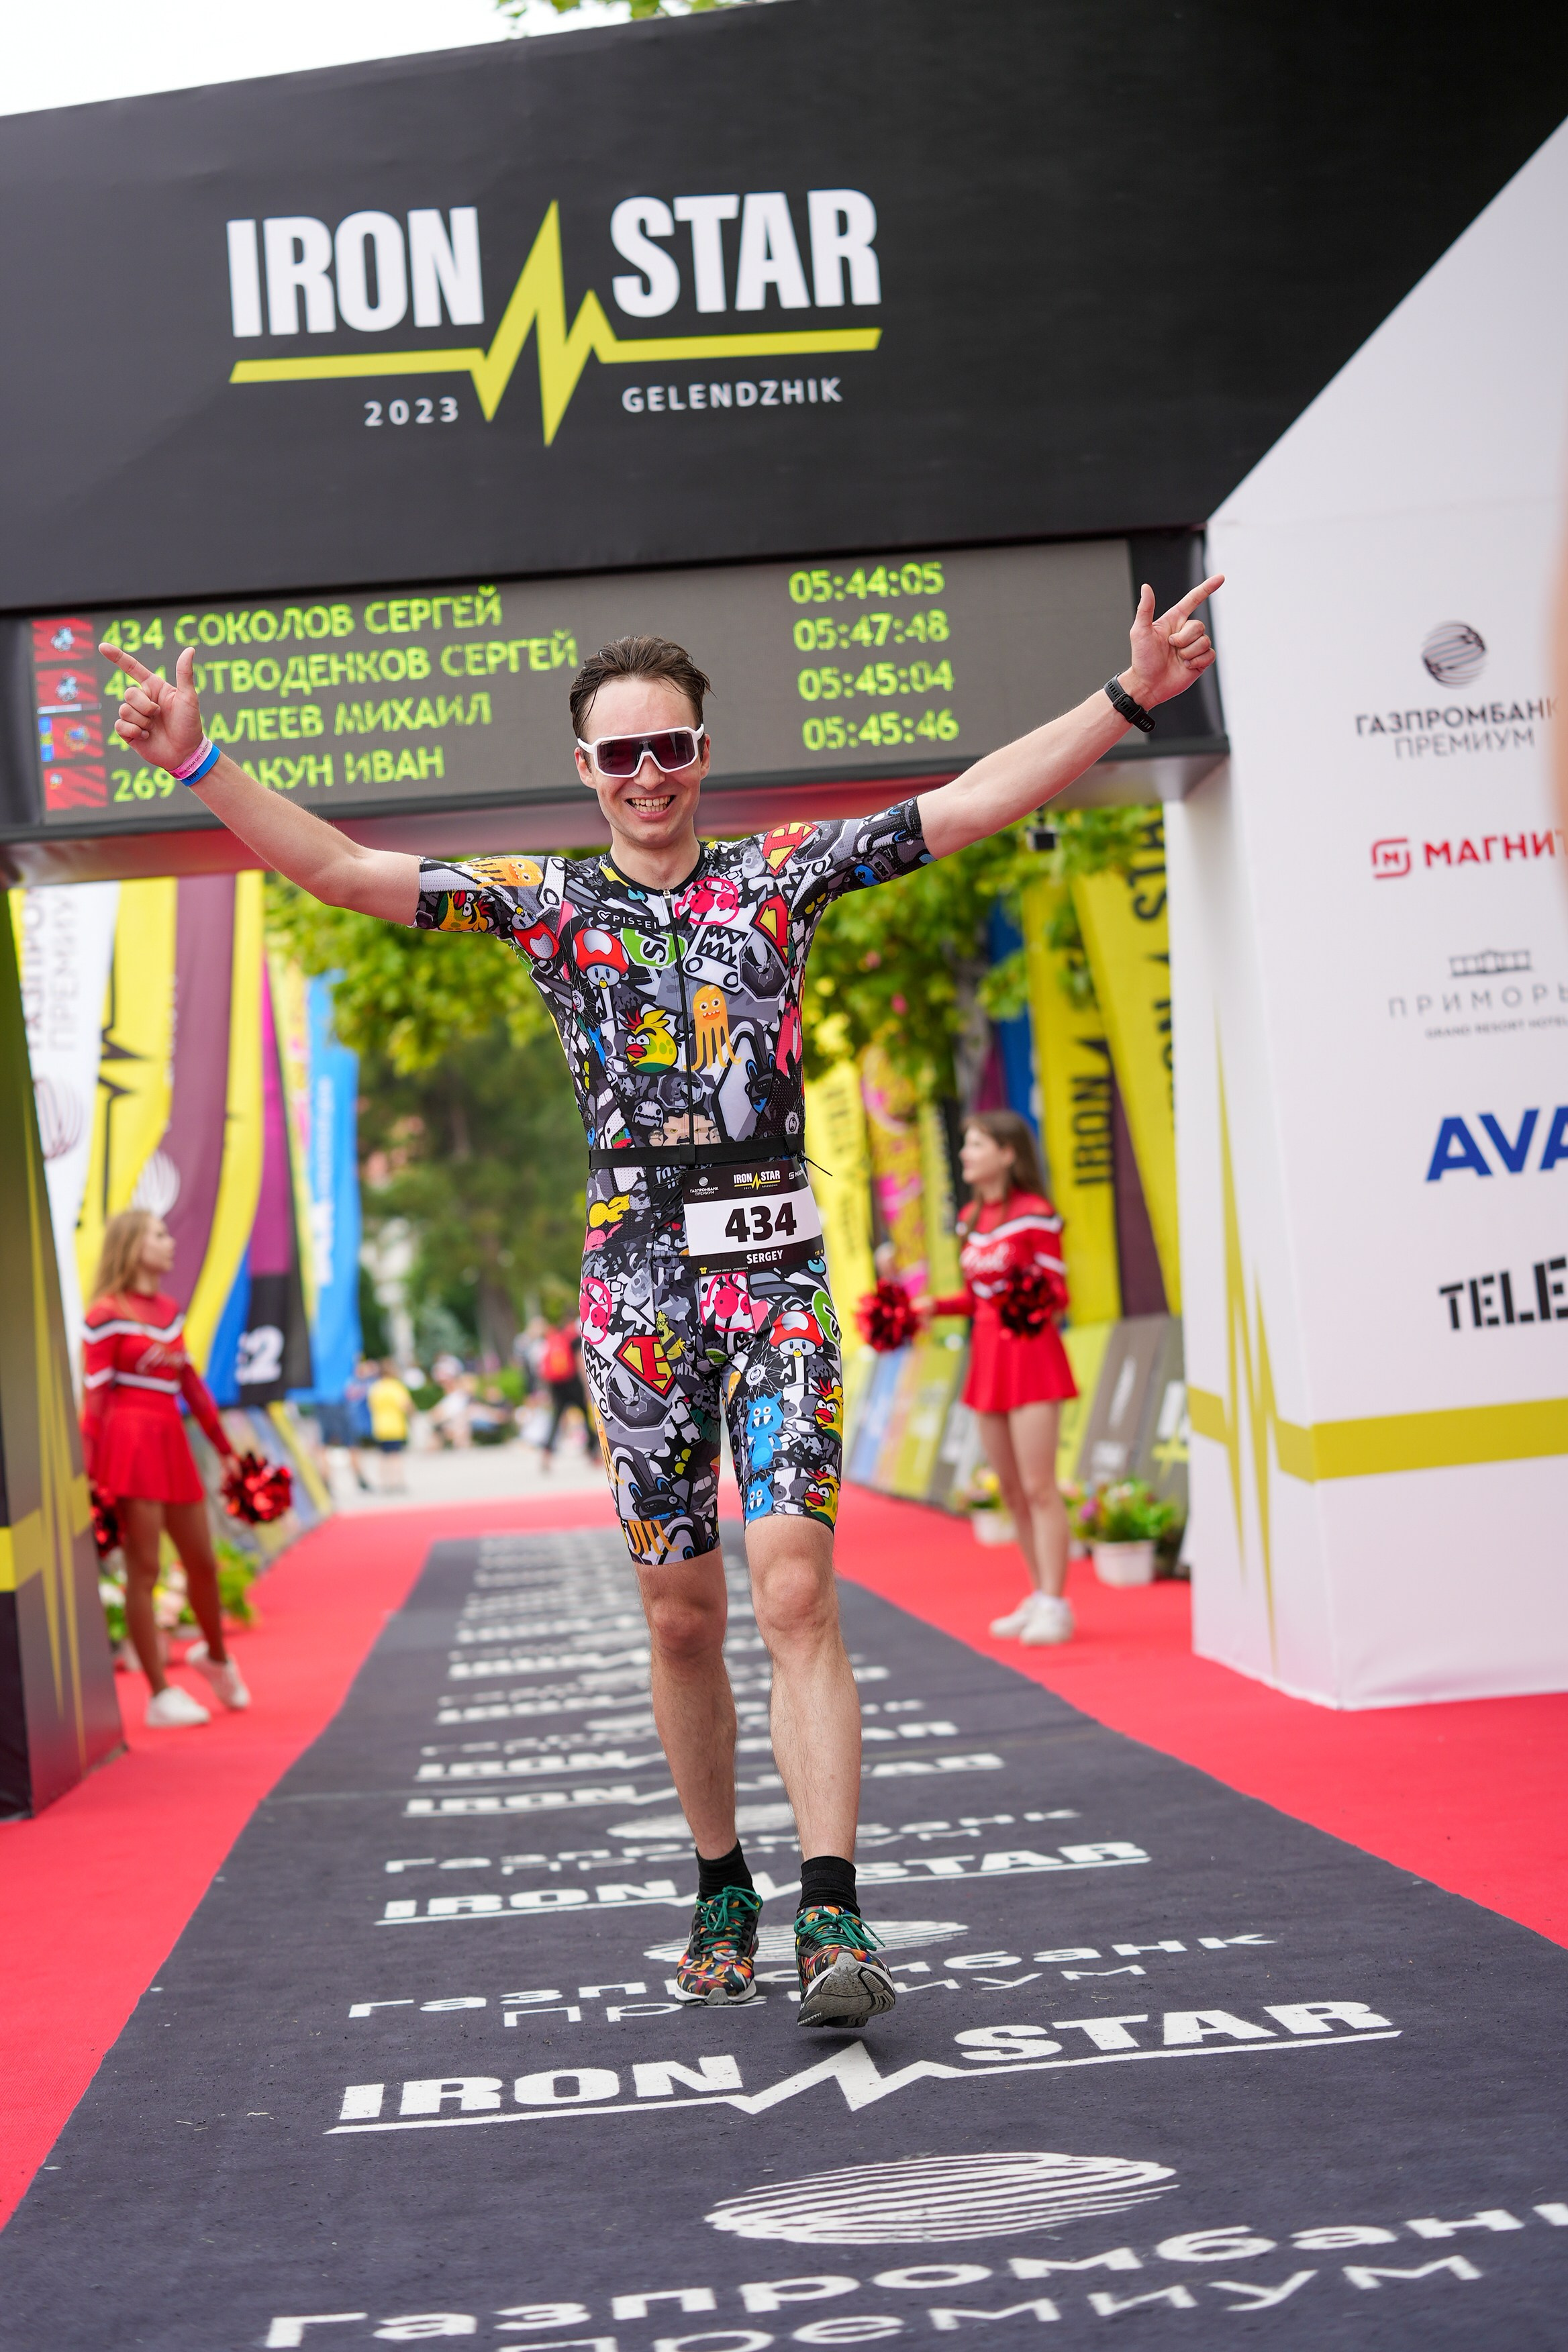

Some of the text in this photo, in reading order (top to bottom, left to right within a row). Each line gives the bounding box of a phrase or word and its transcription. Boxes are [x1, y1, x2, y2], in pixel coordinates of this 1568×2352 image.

[226, 189, 881, 338] IRON STAR
[364, 377, 843, 428] 2023 GELENDZHIK
[788, 561, 945, 604] 05:44:05
[102, 585, 503, 652] 434 СОКОЛОВ СЕРГЕЙ
[793, 609, 950, 652] 05:47:48
[439, 628, 579, 672] СЕРГЕЙ
[797, 658, 955, 701] 05:45:04
[201, 691, 493, 744] АЛЕЕВ МИХАИЛ
[802, 708, 960, 750] 05:45:46
[1394, 727, 1535, 760] ПРЕМИУМ
[111, 766, 176, 802] 269
[345, 744, 445, 784] ИВАН
[1071, 1076, 1112, 1185] IRON
[734, 1170, 781, 1184] IRON STAR
[725, 1202, 797, 1243] 434
[746, 1250, 783, 1265] SERGEY
[385, 1842, 1148, 1918] IRON STAR
[349, 1934, 1278, 2018] Газпобанк
[340, 2002, 1393, 2120] IRON STAR
